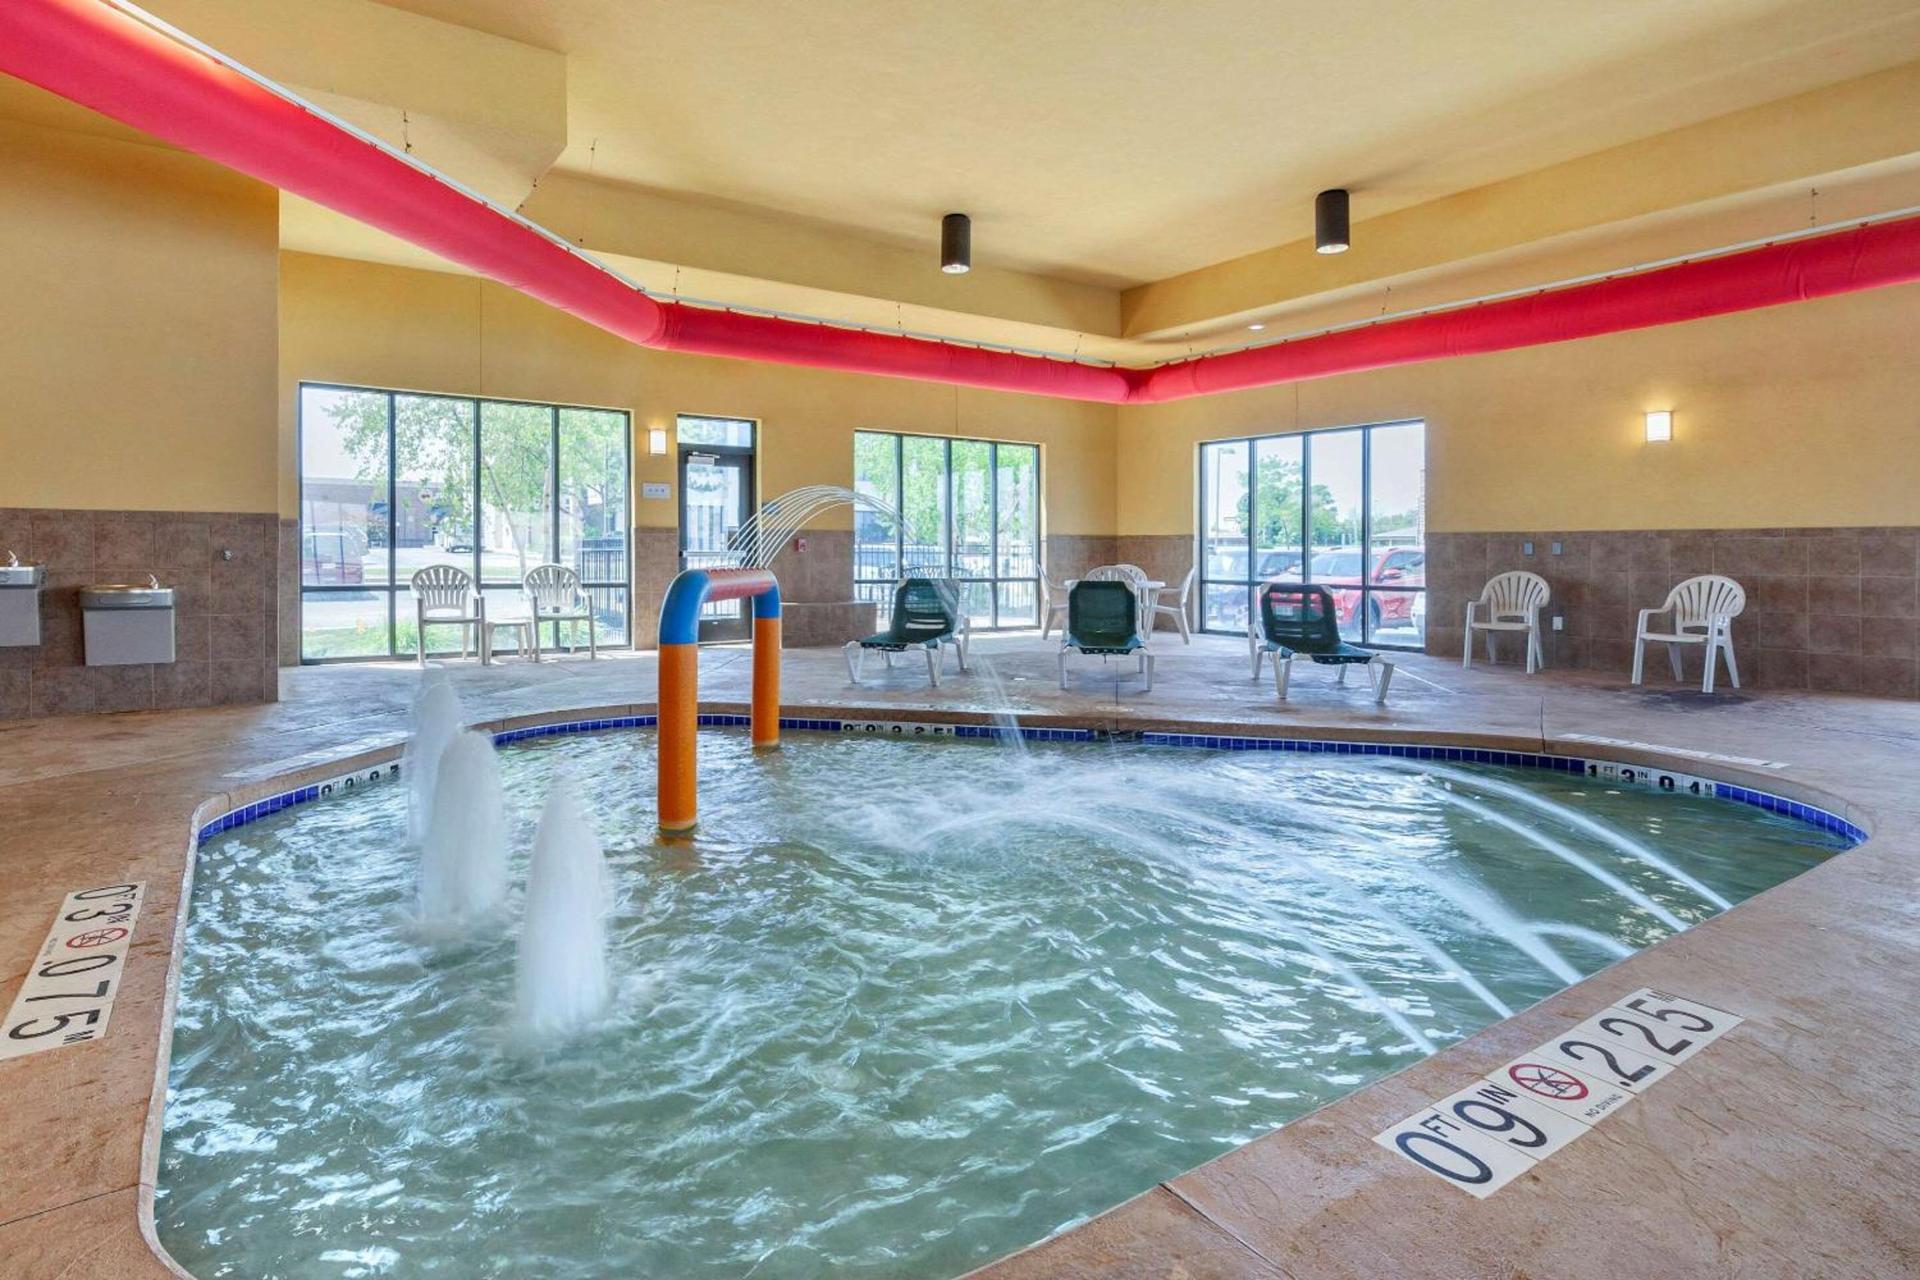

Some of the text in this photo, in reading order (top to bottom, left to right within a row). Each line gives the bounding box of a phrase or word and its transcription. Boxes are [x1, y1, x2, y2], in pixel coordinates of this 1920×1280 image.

[1637, 770, 1649, 779] IN
[74, 884, 138, 900] 0
[64, 903, 134, 922] 3
[1476, 1084, 1518, 1105] IN
[1584, 1093, 1623, 1118] NO DIVING
[1419, 1114, 1461, 1138] FT
[1453, 1100, 1547, 1147] 9
[1395, 1131, 1493, 1184] 0
